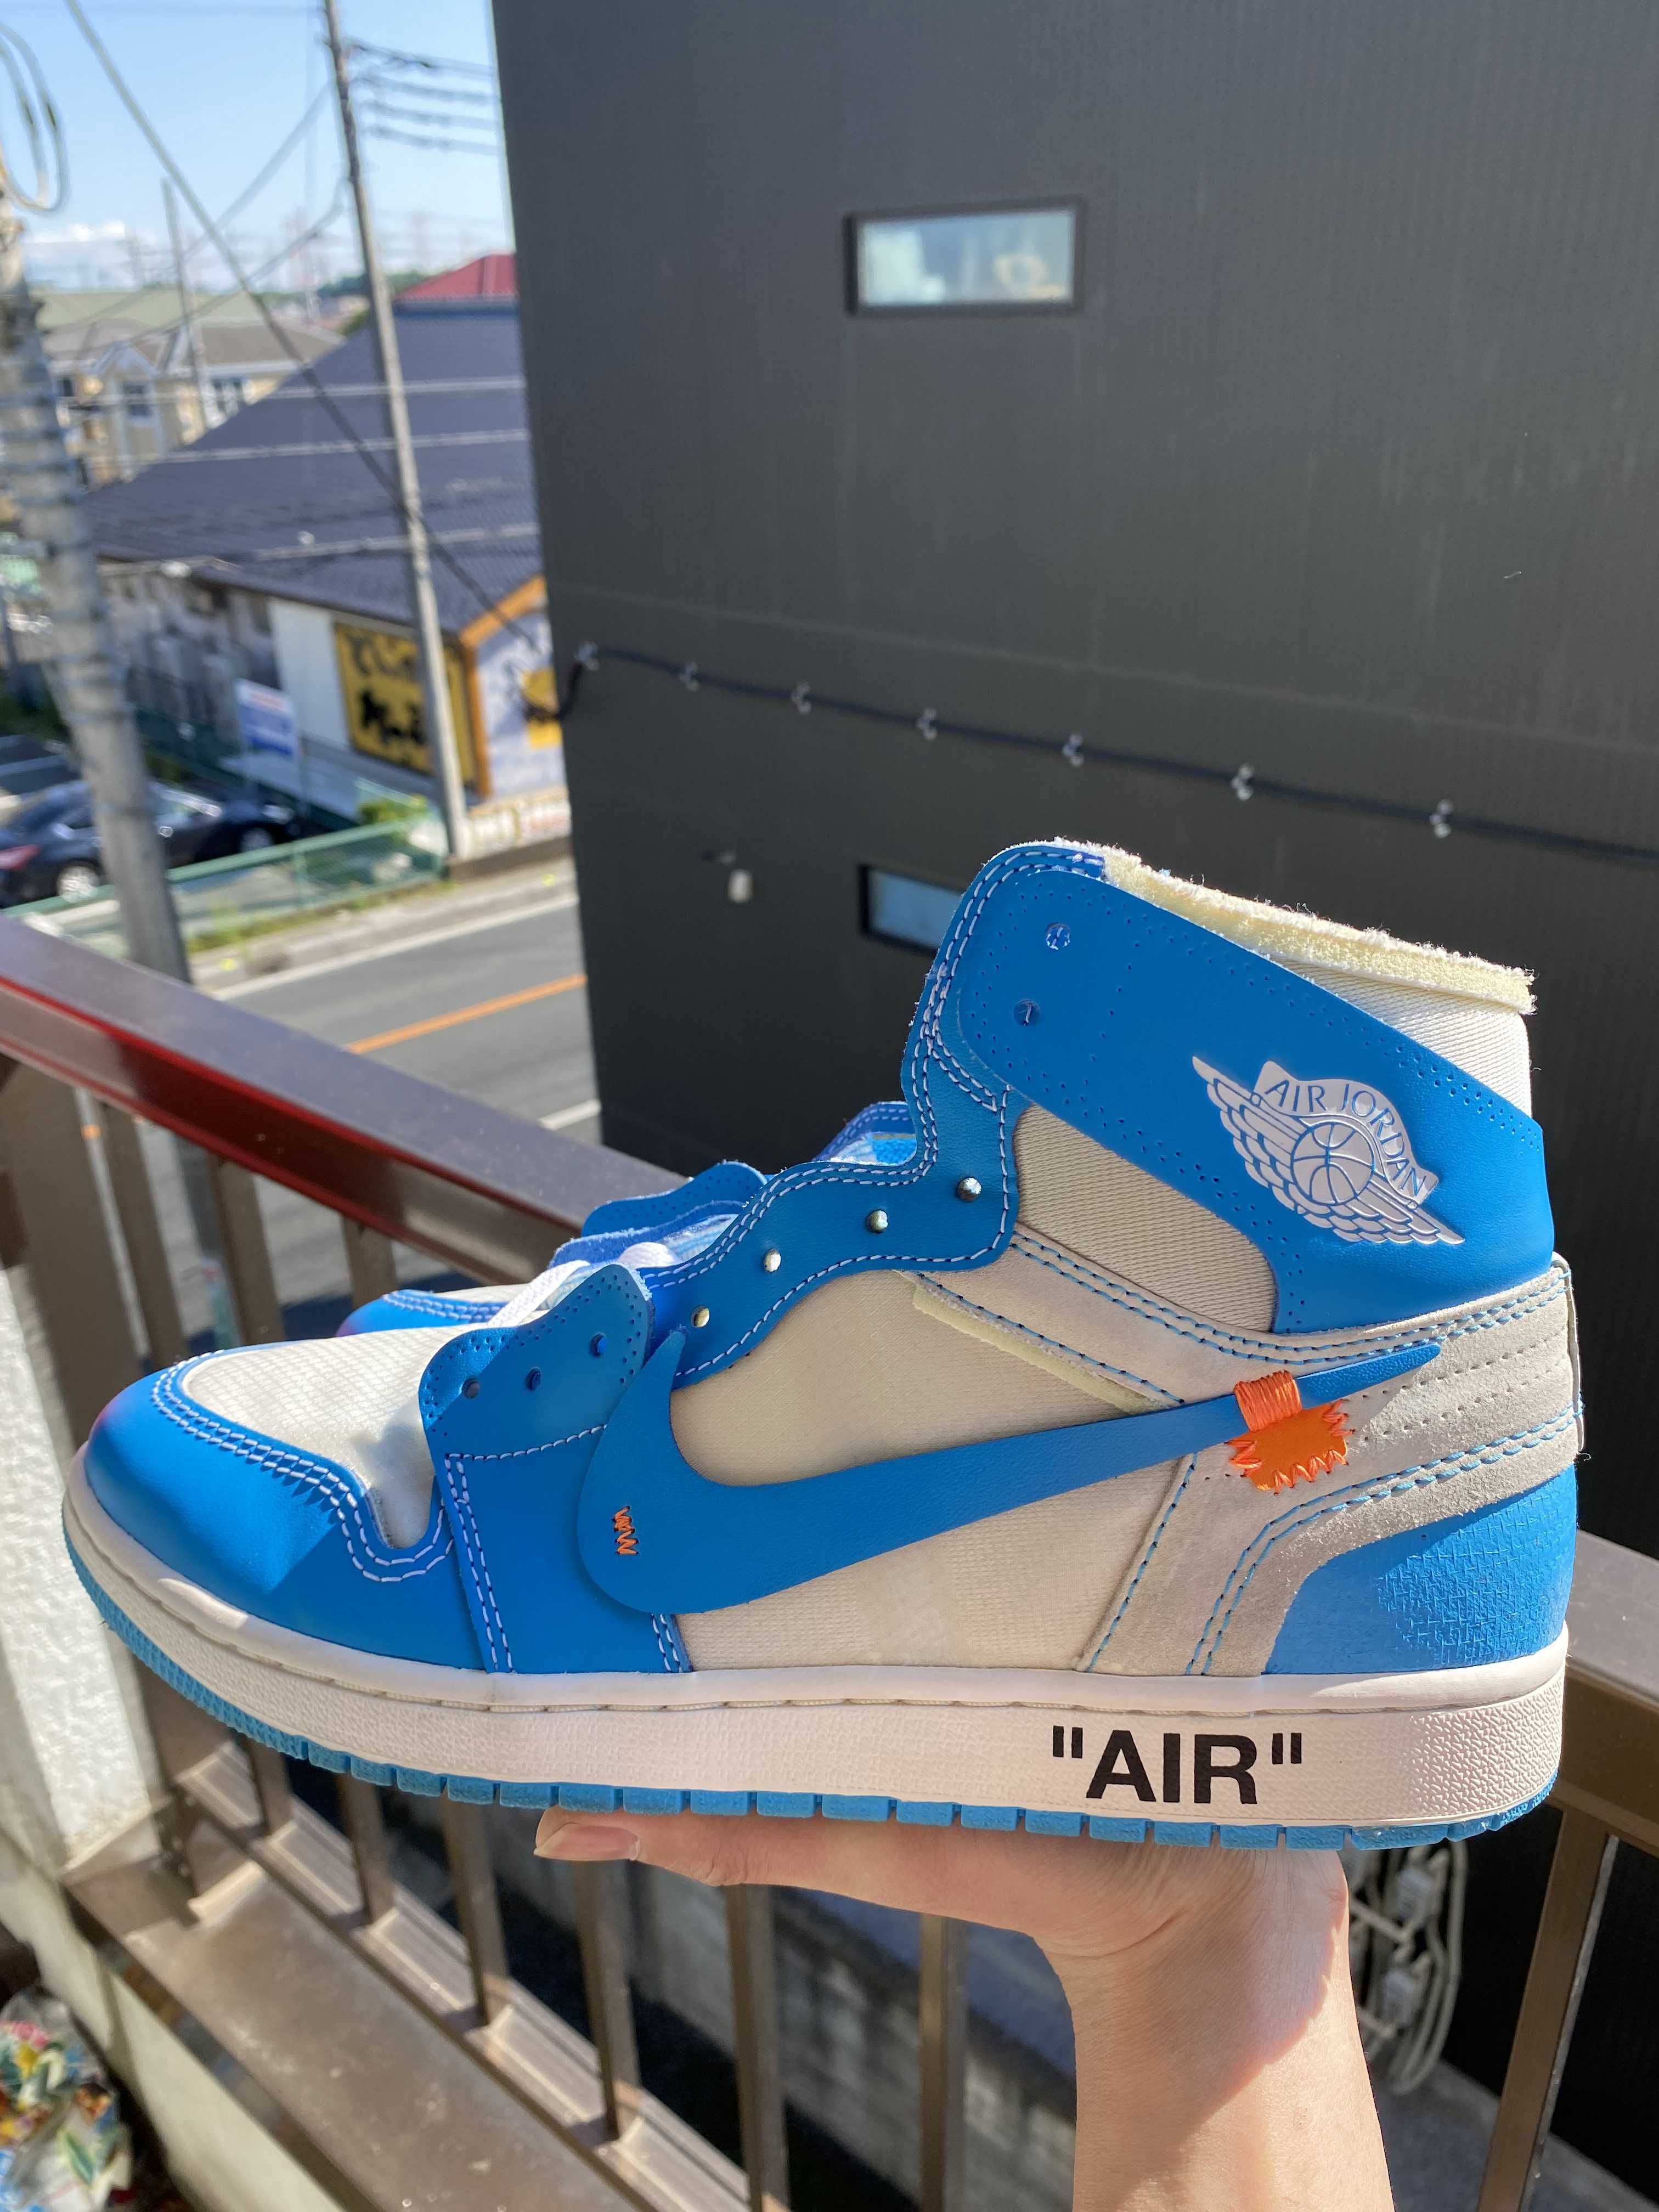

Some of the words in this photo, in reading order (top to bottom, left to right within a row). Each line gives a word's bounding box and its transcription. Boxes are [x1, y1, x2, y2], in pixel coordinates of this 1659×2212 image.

[1265, 1080, 1328, 1112] AIR
[1340, 1084, 1426, 1197] JORDAN
[1052, 1725, 1302, 1804] "AIR"
